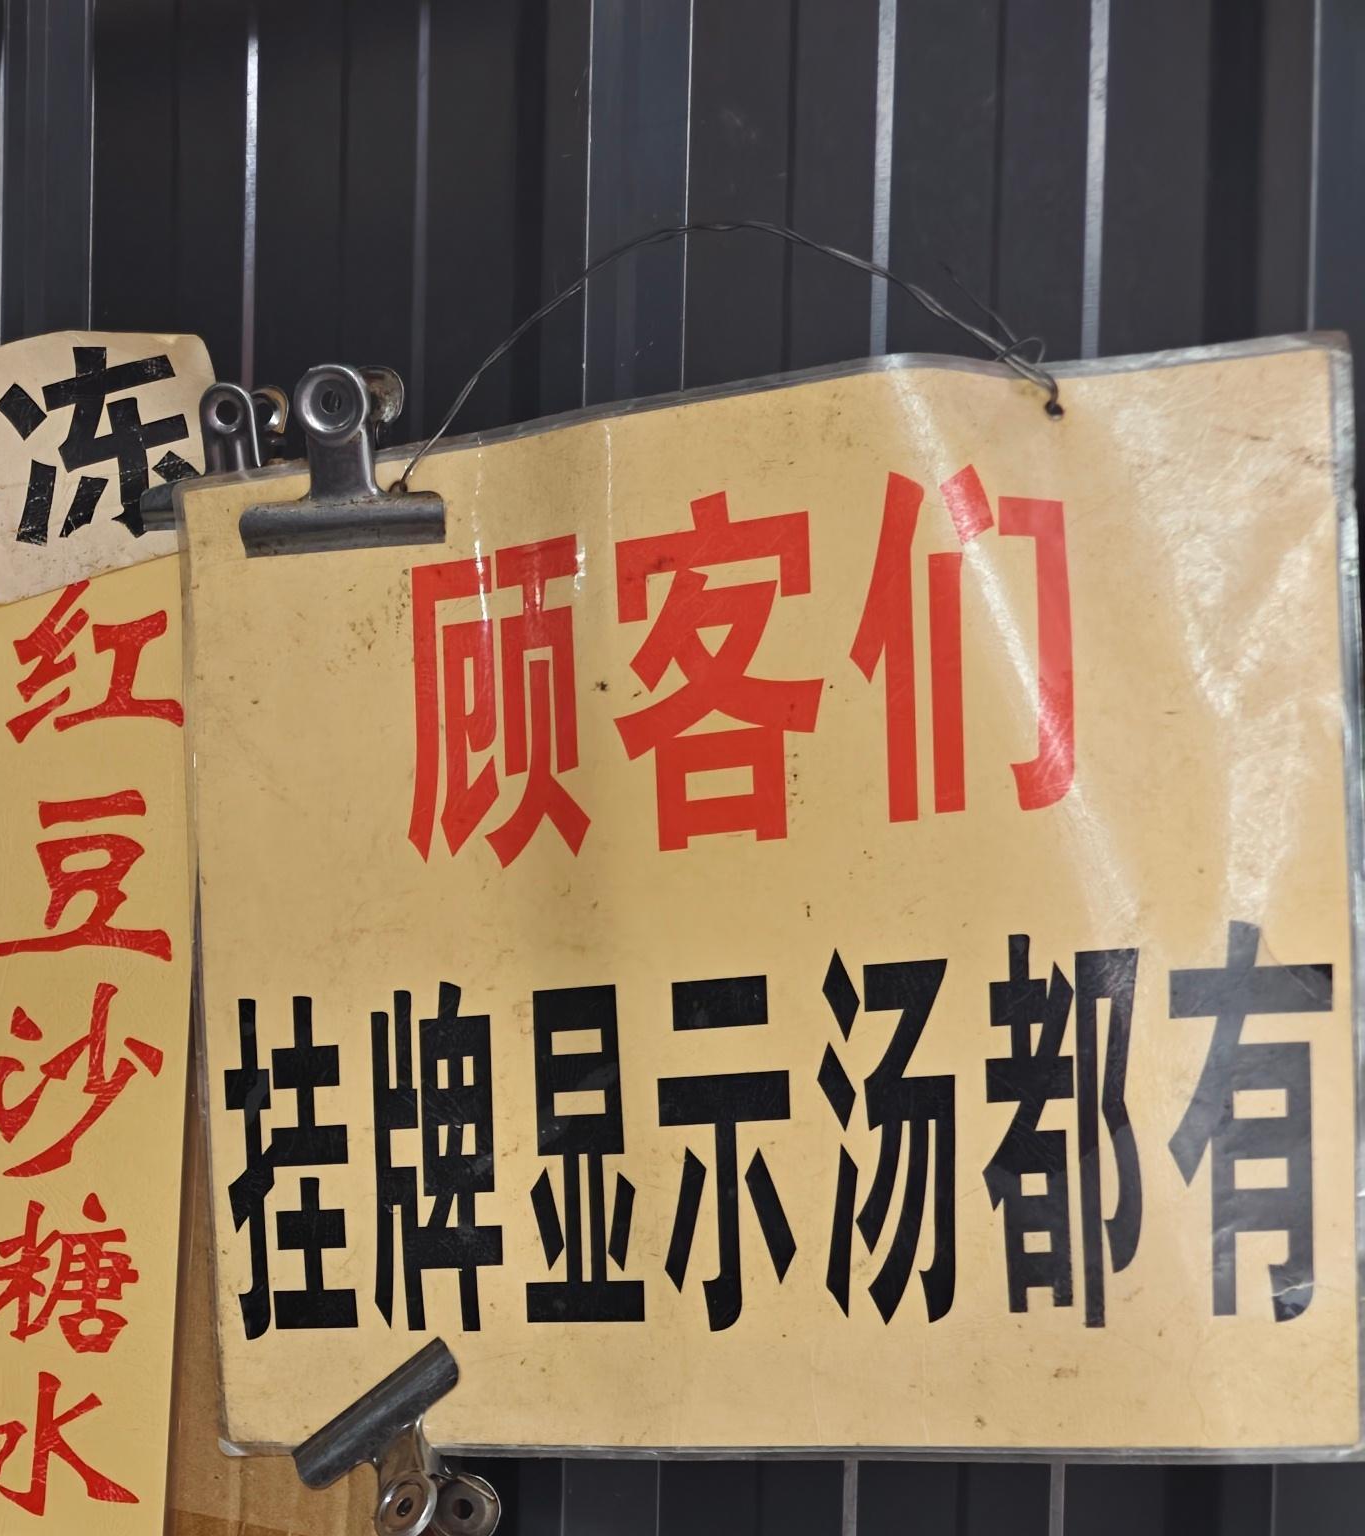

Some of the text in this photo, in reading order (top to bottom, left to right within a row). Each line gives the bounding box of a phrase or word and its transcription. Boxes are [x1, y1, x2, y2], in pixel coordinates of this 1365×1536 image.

[406, 463, 1077, 869] 顾客们
[223, 920, 1334, 1341] 挂牌显示汤都有
